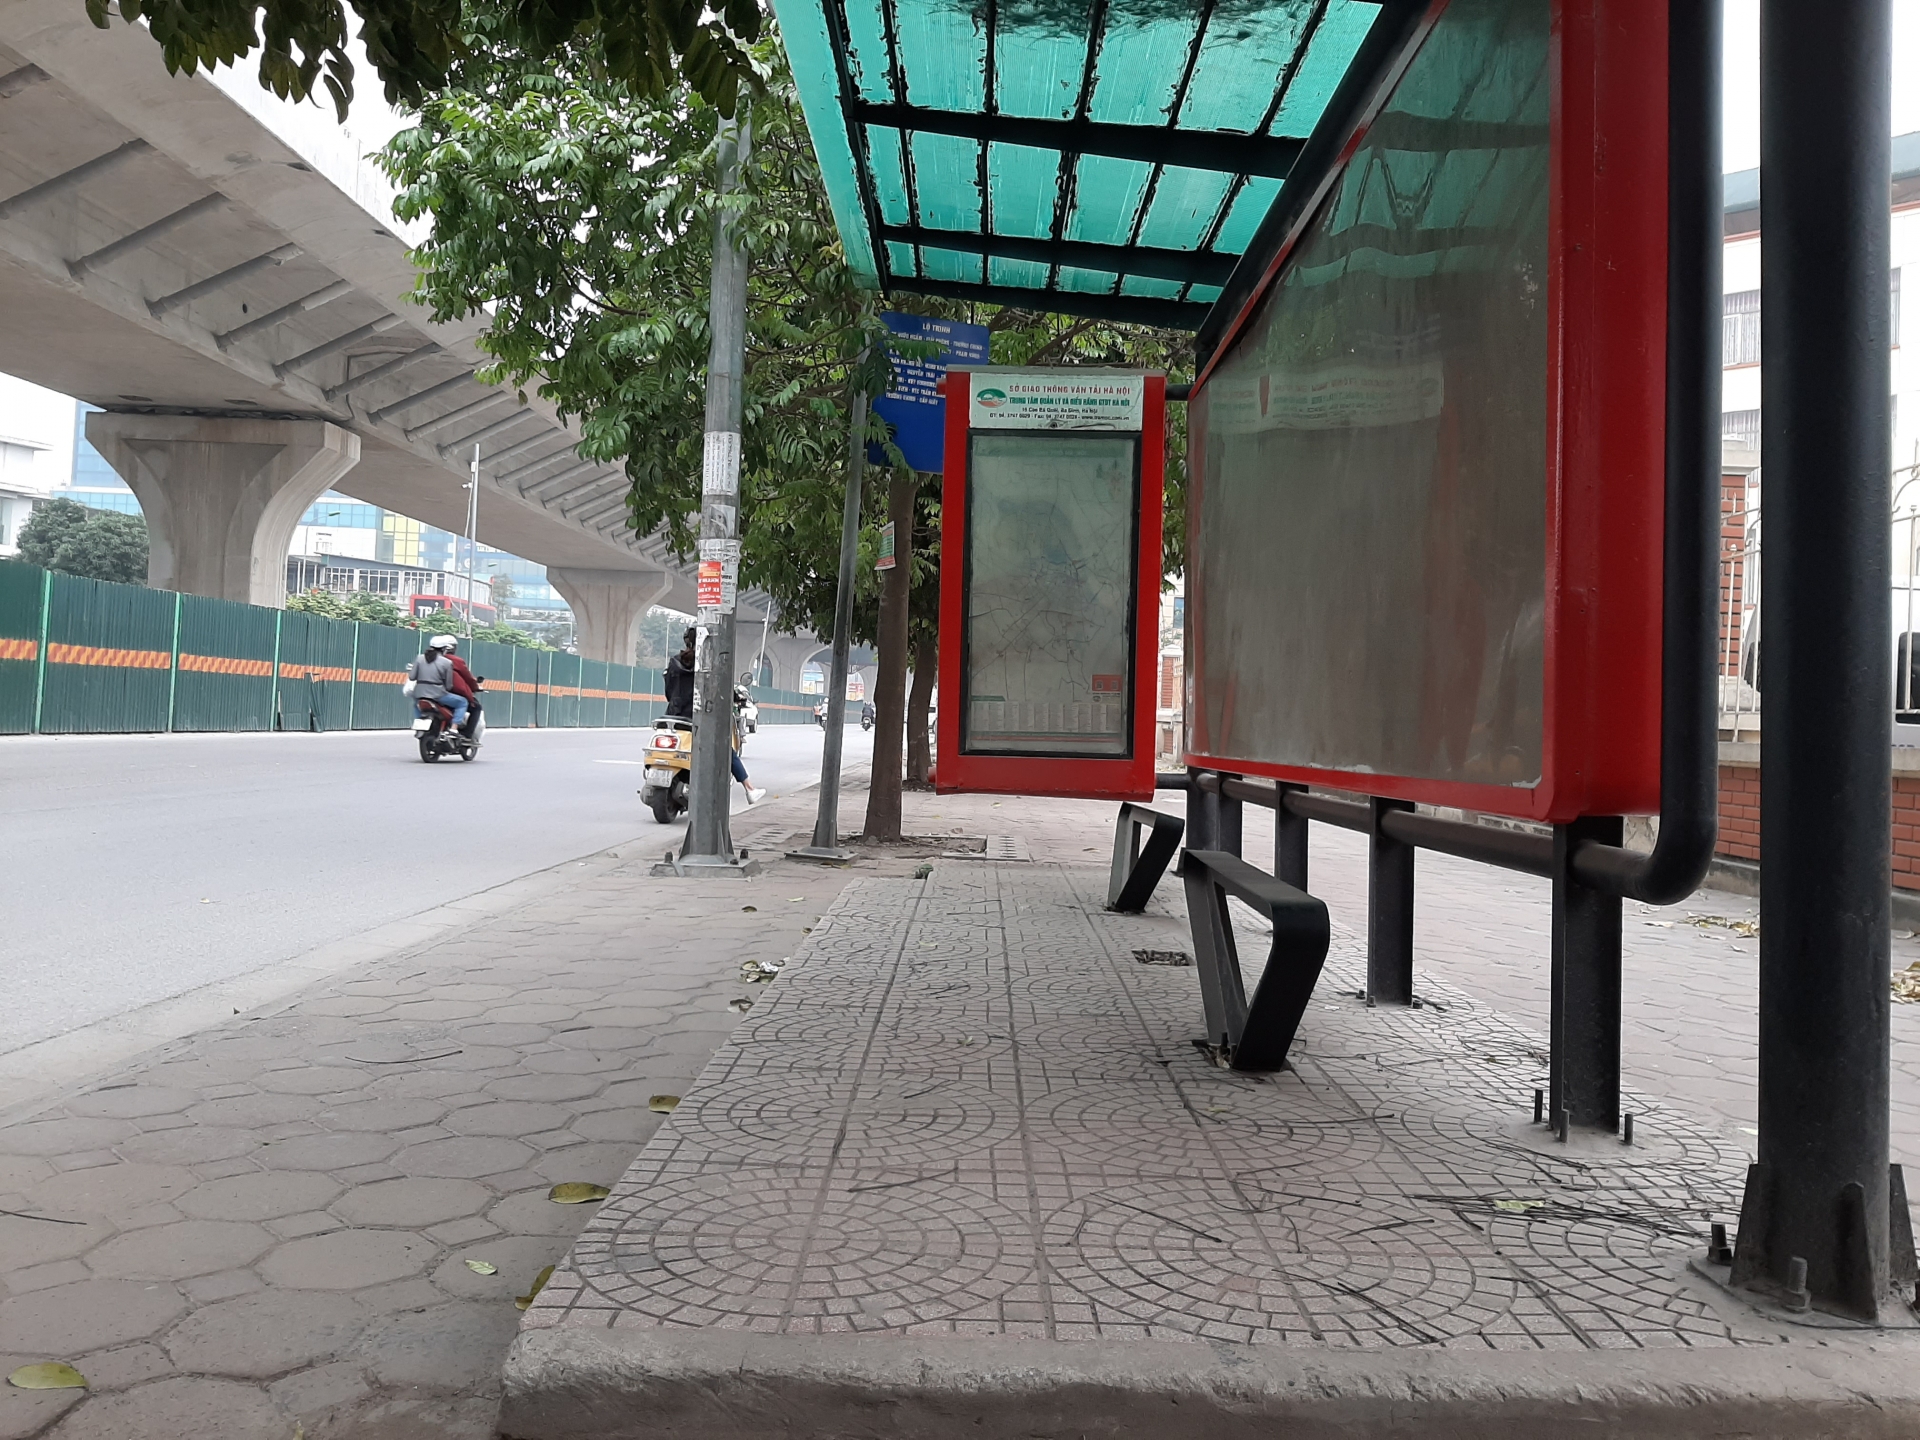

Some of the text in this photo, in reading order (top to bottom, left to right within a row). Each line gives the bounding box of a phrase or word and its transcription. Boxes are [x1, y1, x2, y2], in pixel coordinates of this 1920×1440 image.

[932, 323, 951, 334] TRÌNH
[1009, 382, 1020, 393] SỞ
[1022, 385, 1041, 393] GIAO
[1043, 384, 1069, 394] THÔNG
[1089, 384, 1102, 395] TẢI
[1104, 385, 1114, 395] HÀ
[1117, 386, 1130, 397] NỘI
